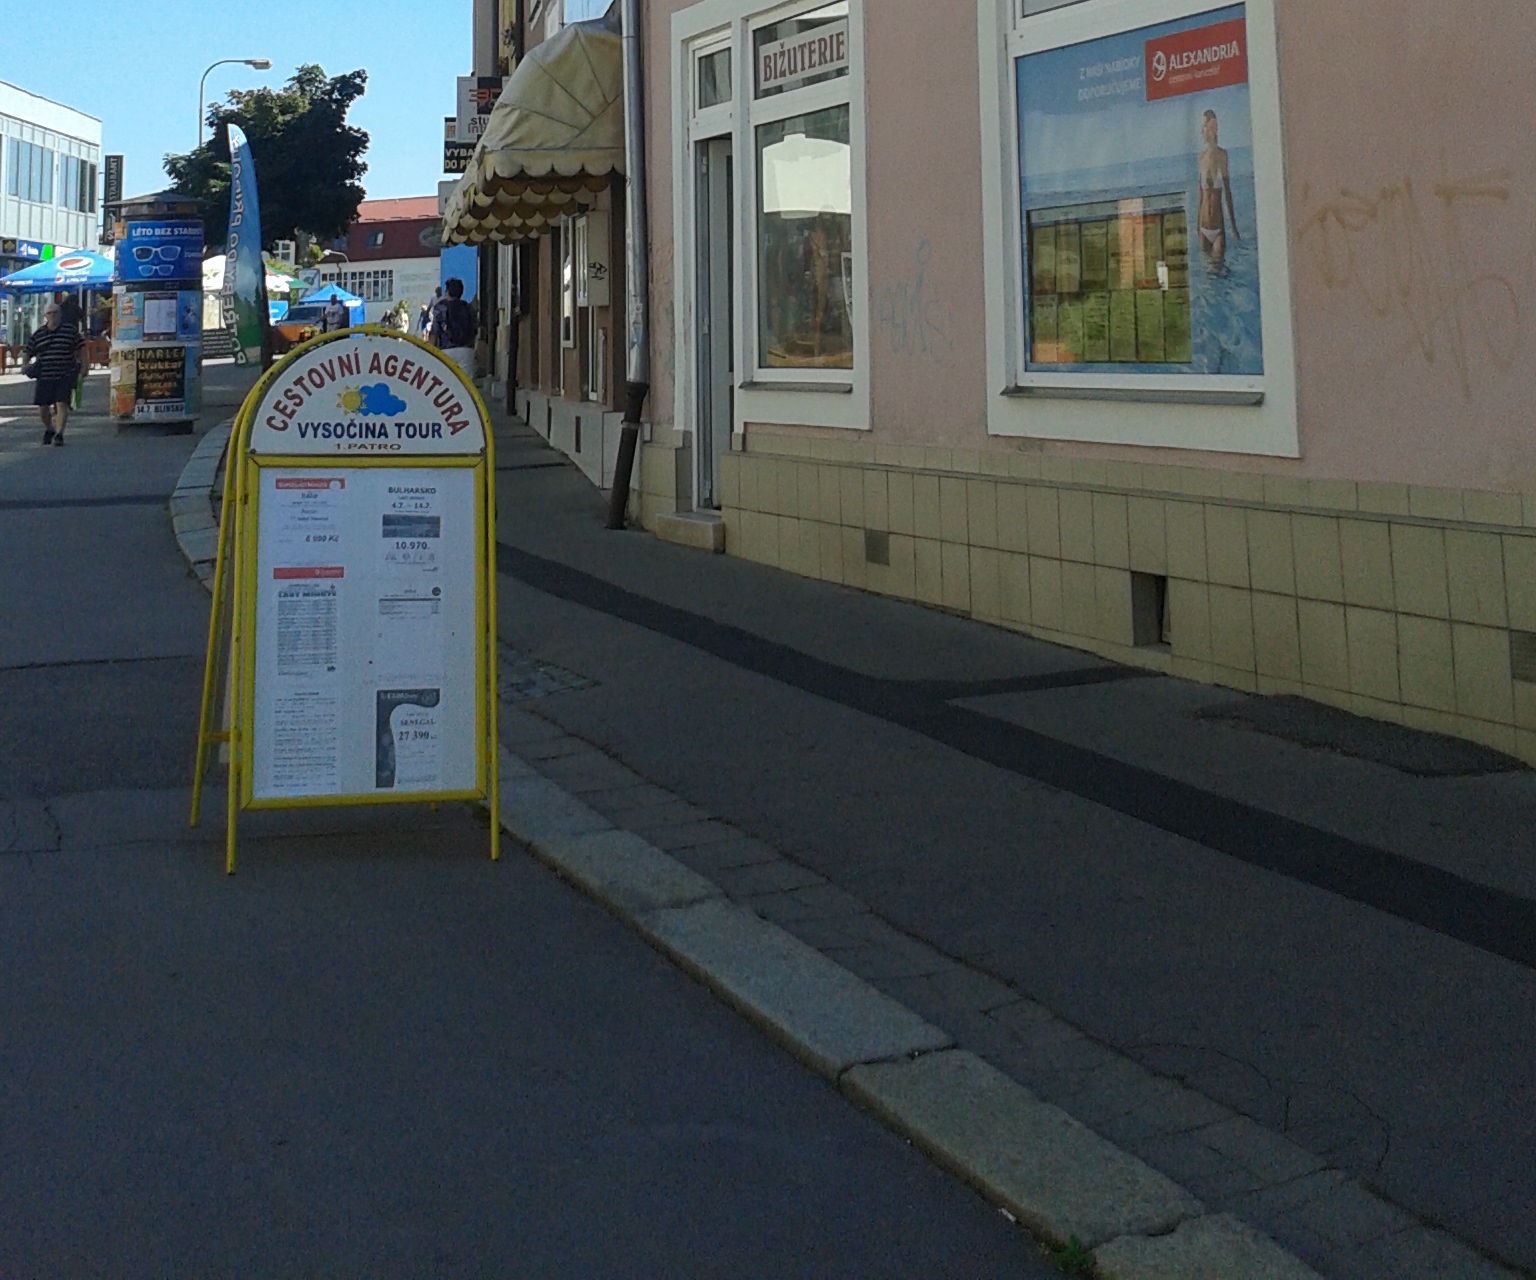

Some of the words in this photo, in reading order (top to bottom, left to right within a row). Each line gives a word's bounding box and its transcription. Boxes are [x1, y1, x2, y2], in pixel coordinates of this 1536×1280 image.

[763, 30, 846, 83] BIŽUTERIE
[1168, 40, 1240, 71] ALEXANDRIA
[445, 148, 475, 157] VYBA
[265, 346, 361, 432] CESTOVNÍ
[368, 351, 470, 437] AGENTURA
[297, 418, 388, 439] VYSOČINA
[394, 422, 443, 440] TOUR
